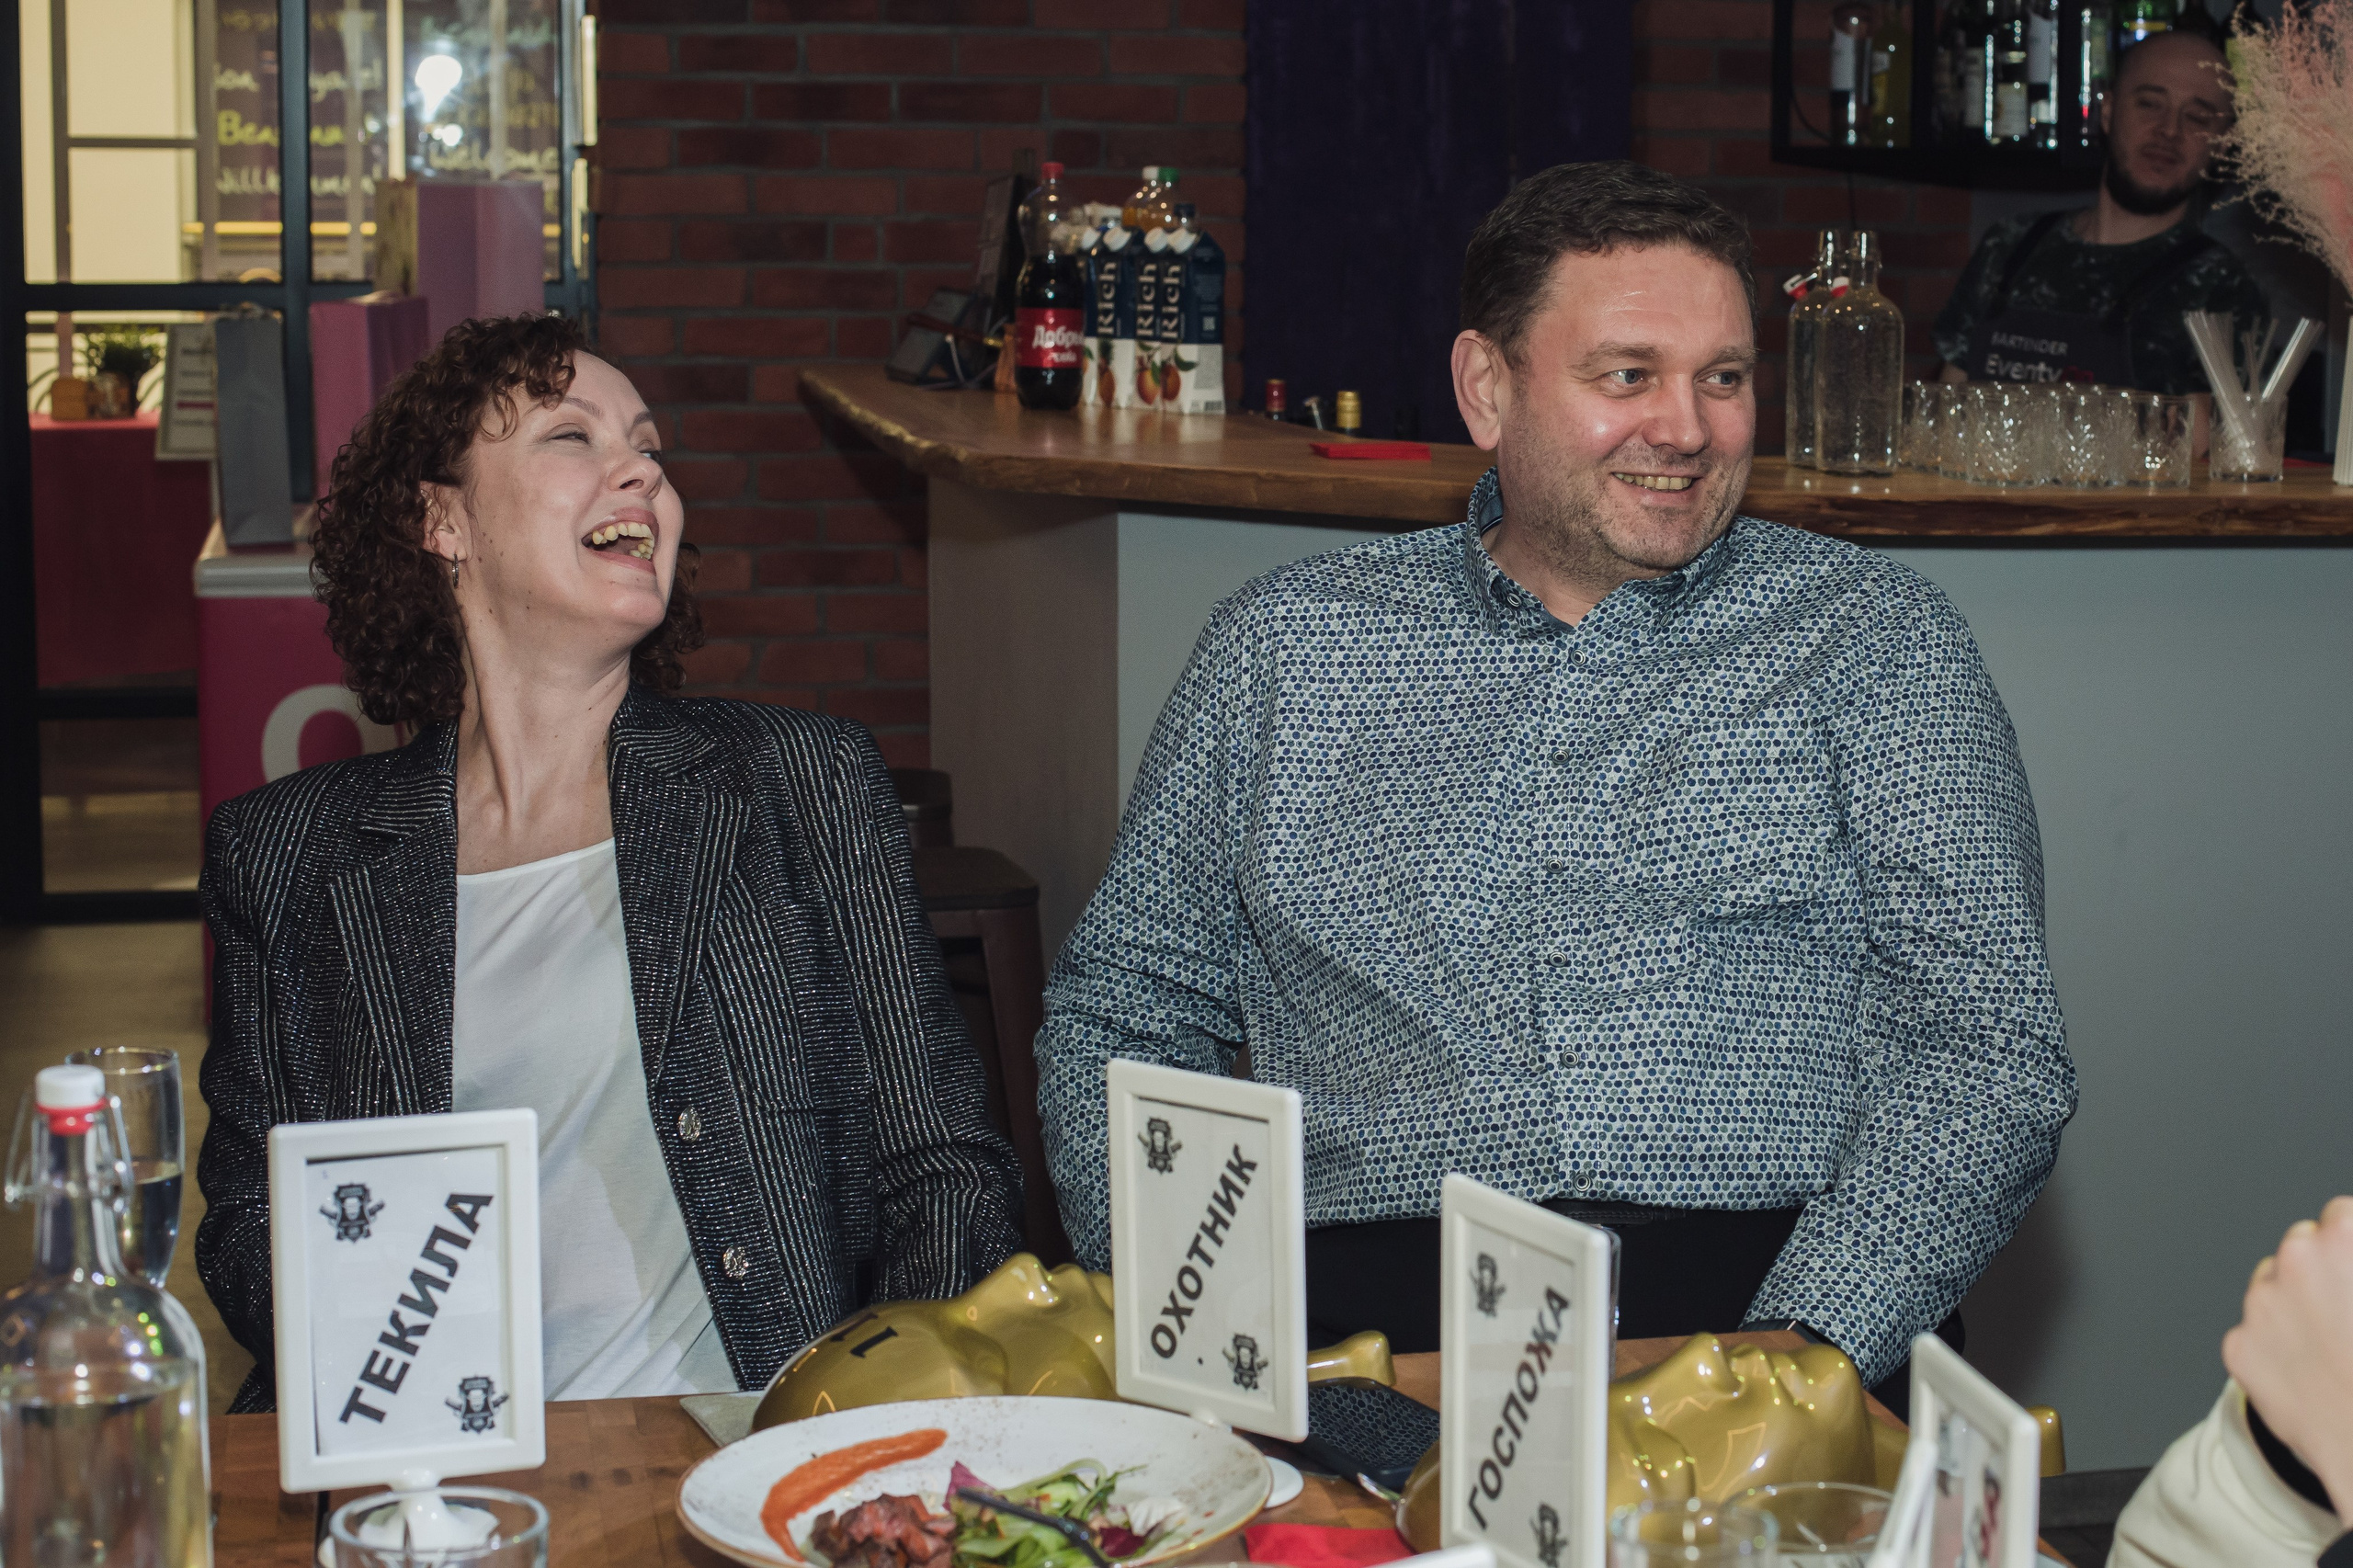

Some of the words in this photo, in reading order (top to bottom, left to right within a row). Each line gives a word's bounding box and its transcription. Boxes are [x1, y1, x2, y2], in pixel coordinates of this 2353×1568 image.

[1097, 262, 1117, 335] Rich
[1136, 263, 1157, 336] Rich
[1161, 265, 1181, 339] Rich
[338, 1191, 494, 1426] ТЕКИЛА
[1151, 1143, 1258, 1359] ОХОТНИК
[1468, 1285, 1572, 1530] ГОСПОЖА
